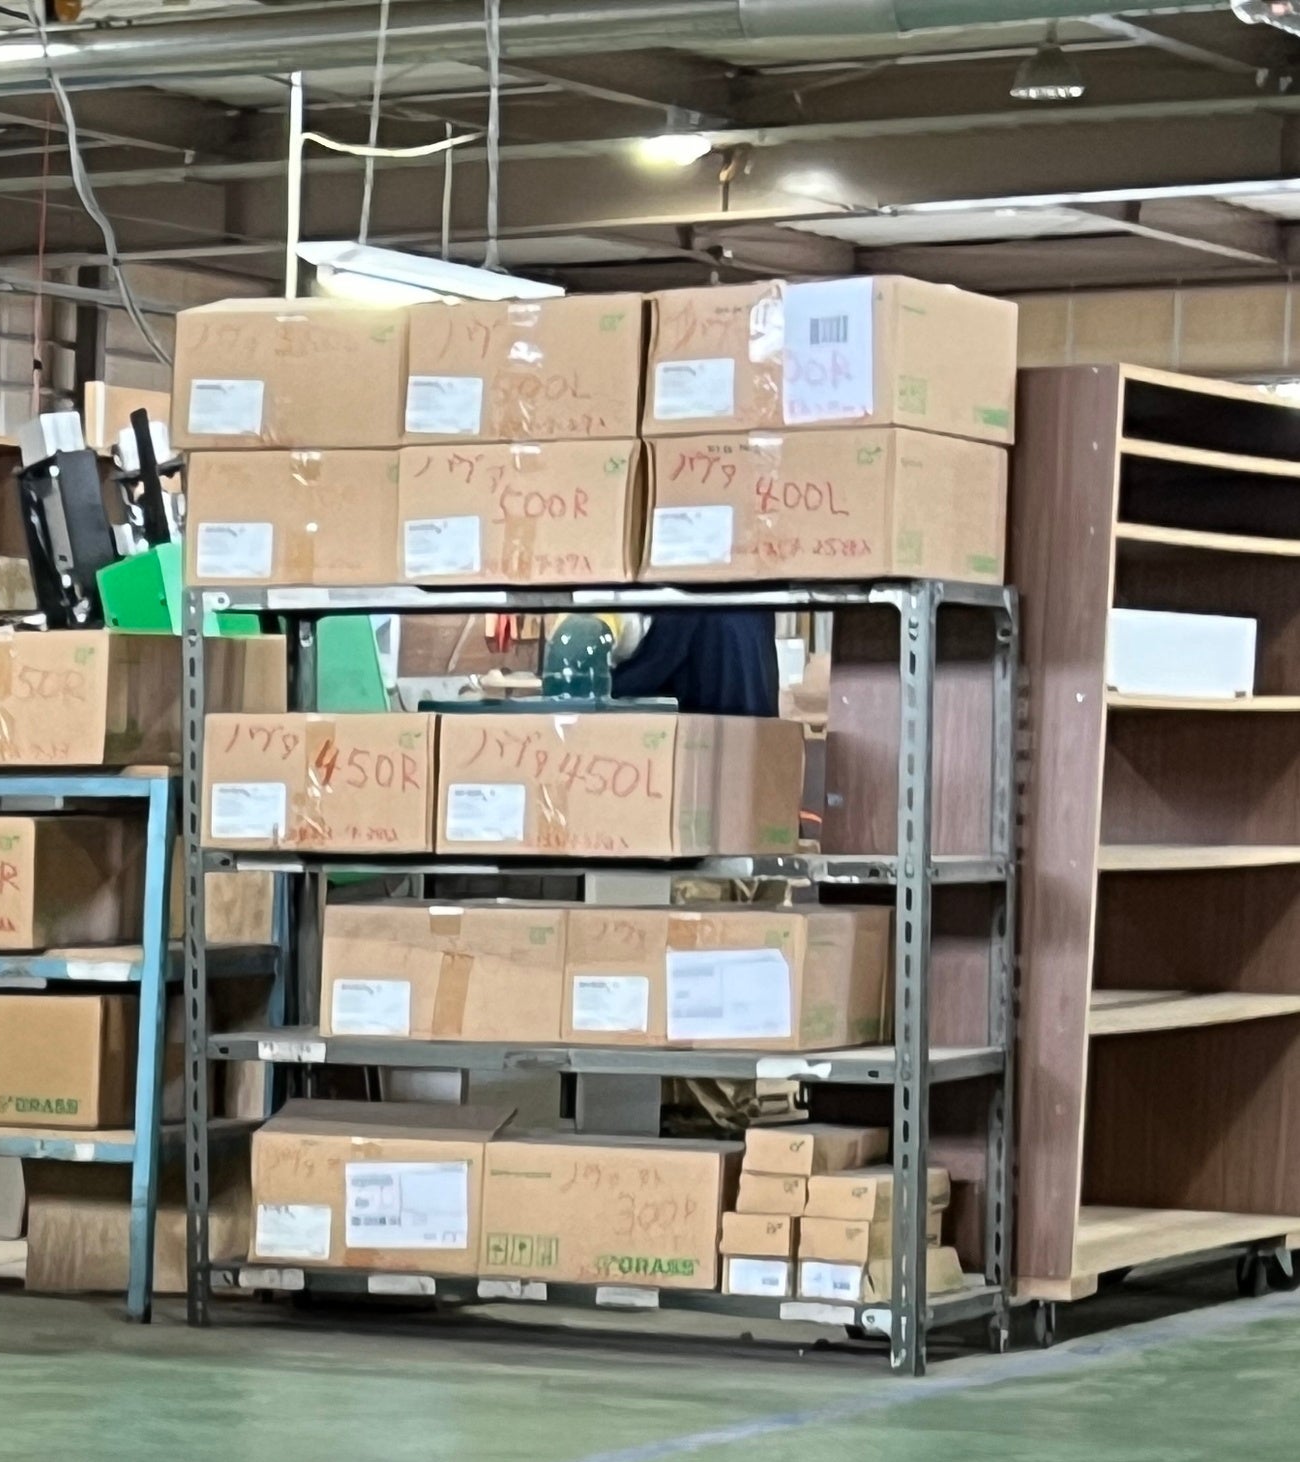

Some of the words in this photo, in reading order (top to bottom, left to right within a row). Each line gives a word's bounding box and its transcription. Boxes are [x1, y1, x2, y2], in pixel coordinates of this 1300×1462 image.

[492, 484, 590, 525] 500R
[754, 475, 850, 517] 400L
[313, 738, 422, 793] 450R
[557, 751, 664, 799] 450L
